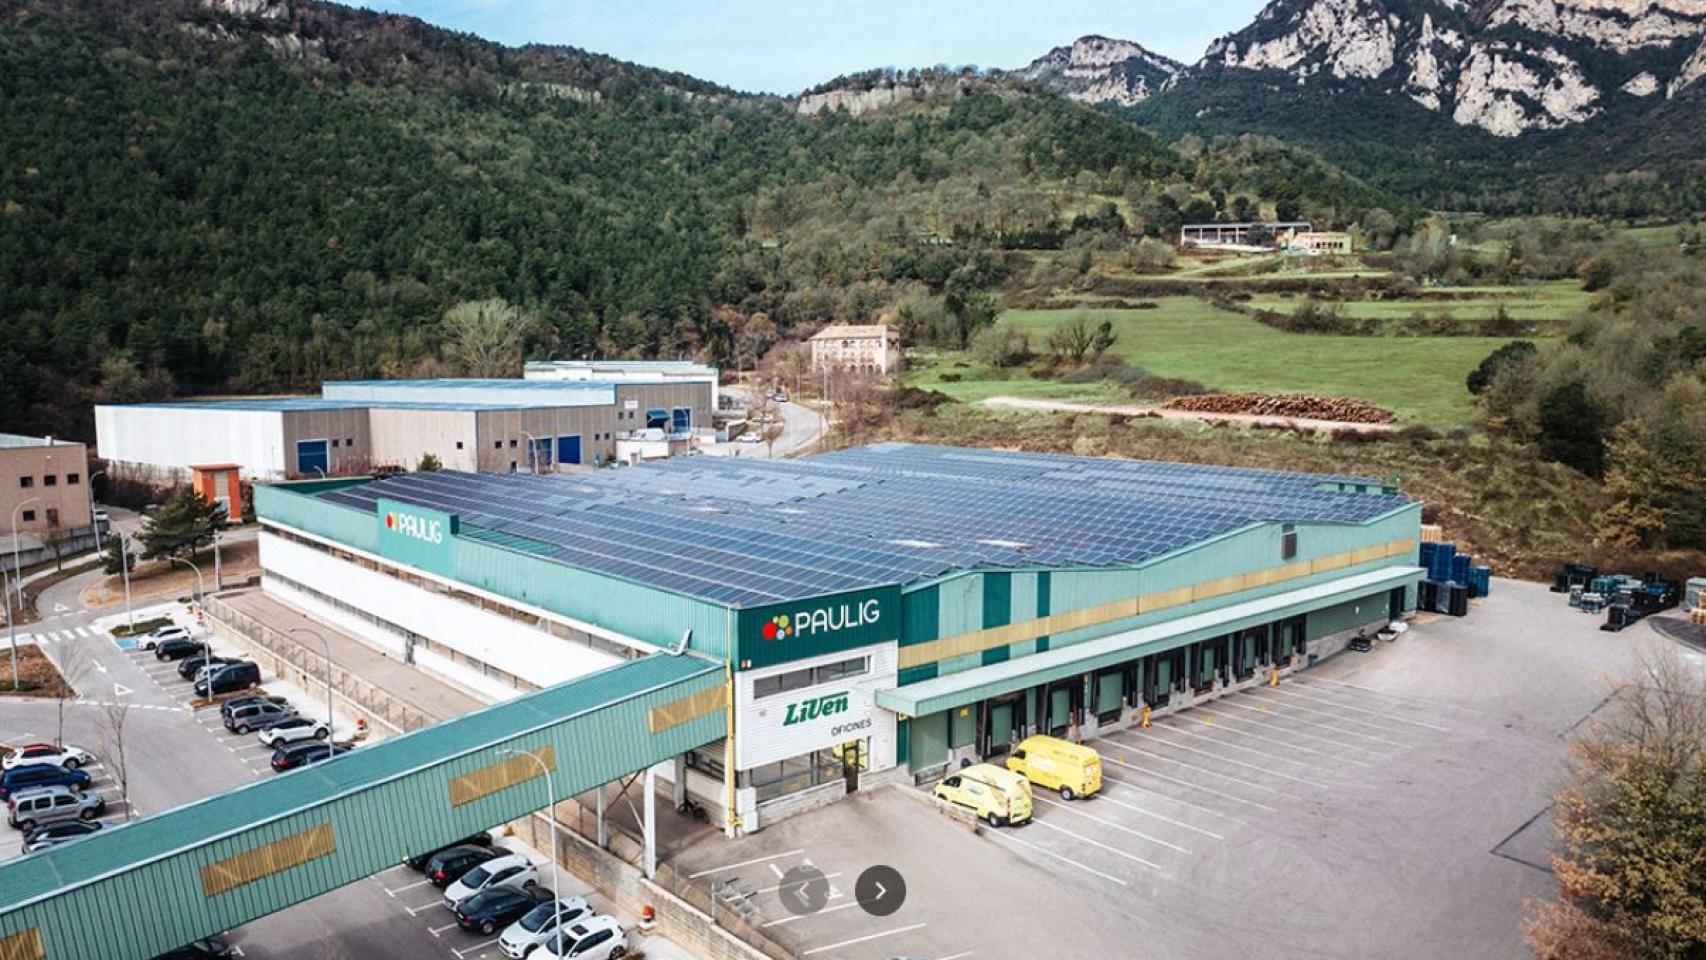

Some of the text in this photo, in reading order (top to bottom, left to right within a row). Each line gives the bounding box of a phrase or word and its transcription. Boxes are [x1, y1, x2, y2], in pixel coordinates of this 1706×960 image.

[399, 512, 442, 544] PAULIG
[795, 599, 880, 637] PAULIG
[831, 718, 872, 736] OFICINES
